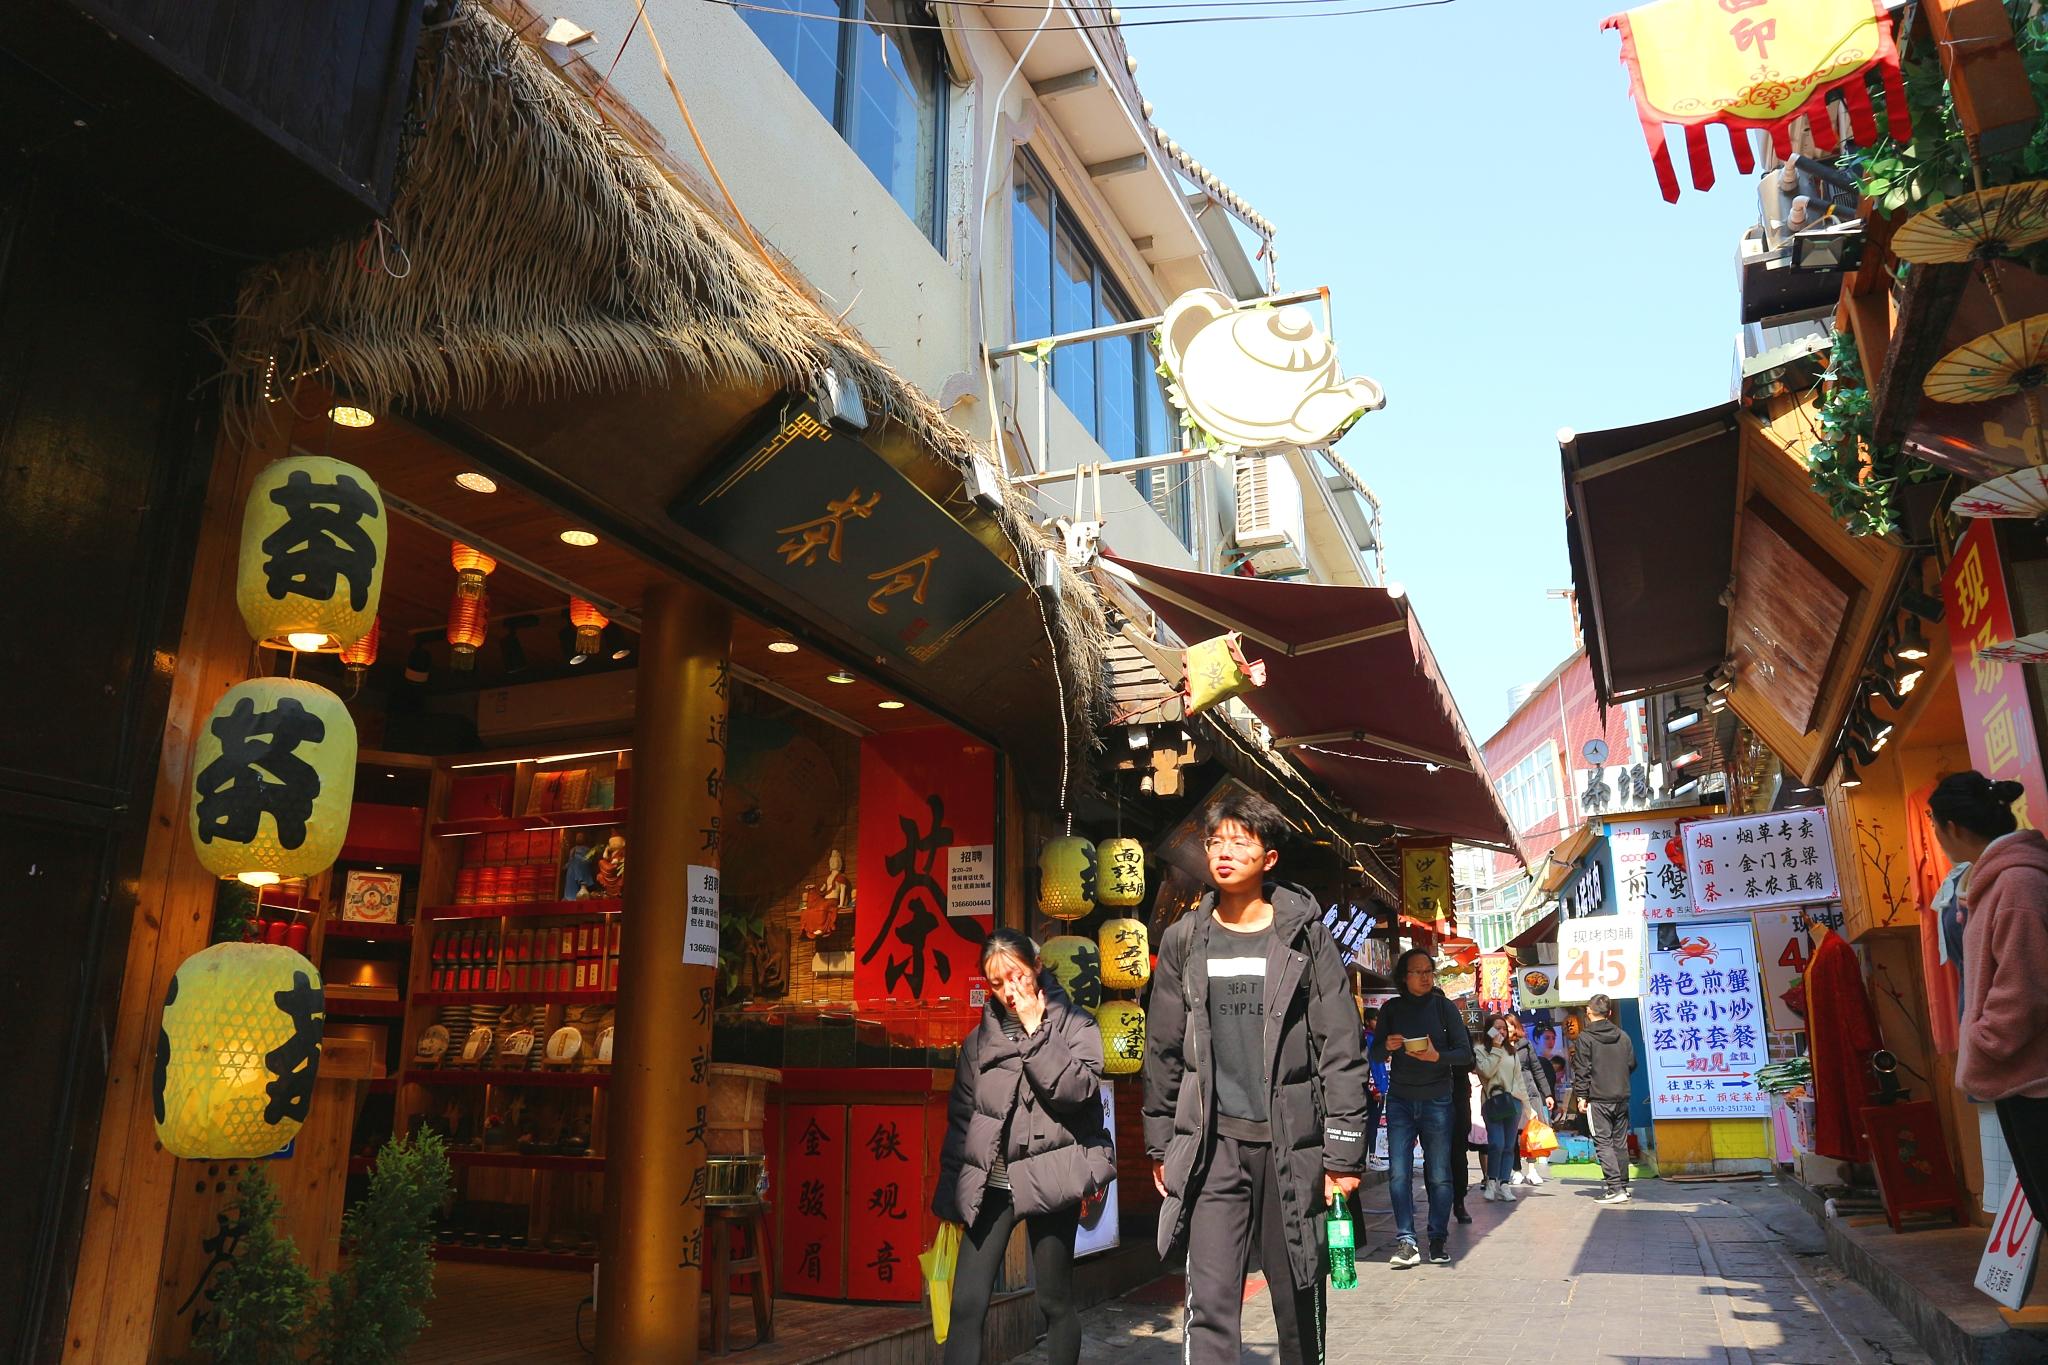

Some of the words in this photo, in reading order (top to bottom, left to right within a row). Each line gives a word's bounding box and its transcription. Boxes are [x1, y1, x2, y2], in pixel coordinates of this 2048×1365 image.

[960, 851, 983, 863] 招聘
[861, 794, 986, 998] 茶
[1416, 856, 1440, 911] 沙茶面
[1649, 969, 1750, 996] 特色煎蟹
[1650, 997, 1754, 1023] 家常小炒
[1119, 1012, 1145, 1060] 沙茶面
[1653, 1024, 1756, 1051] 经济套餐
[1686, 1051, 1731, 1073] 初见
[1658, 1093, 1707, 1103] 来料加工
[1668, 1079, 1715, 1091] 往里5米
[1708, 1104, 1756, 1112] 0592-2517302
[797, 1118, 831, 1283] 金骏眉
[866, 1121, 909, 1283] 铁观音
